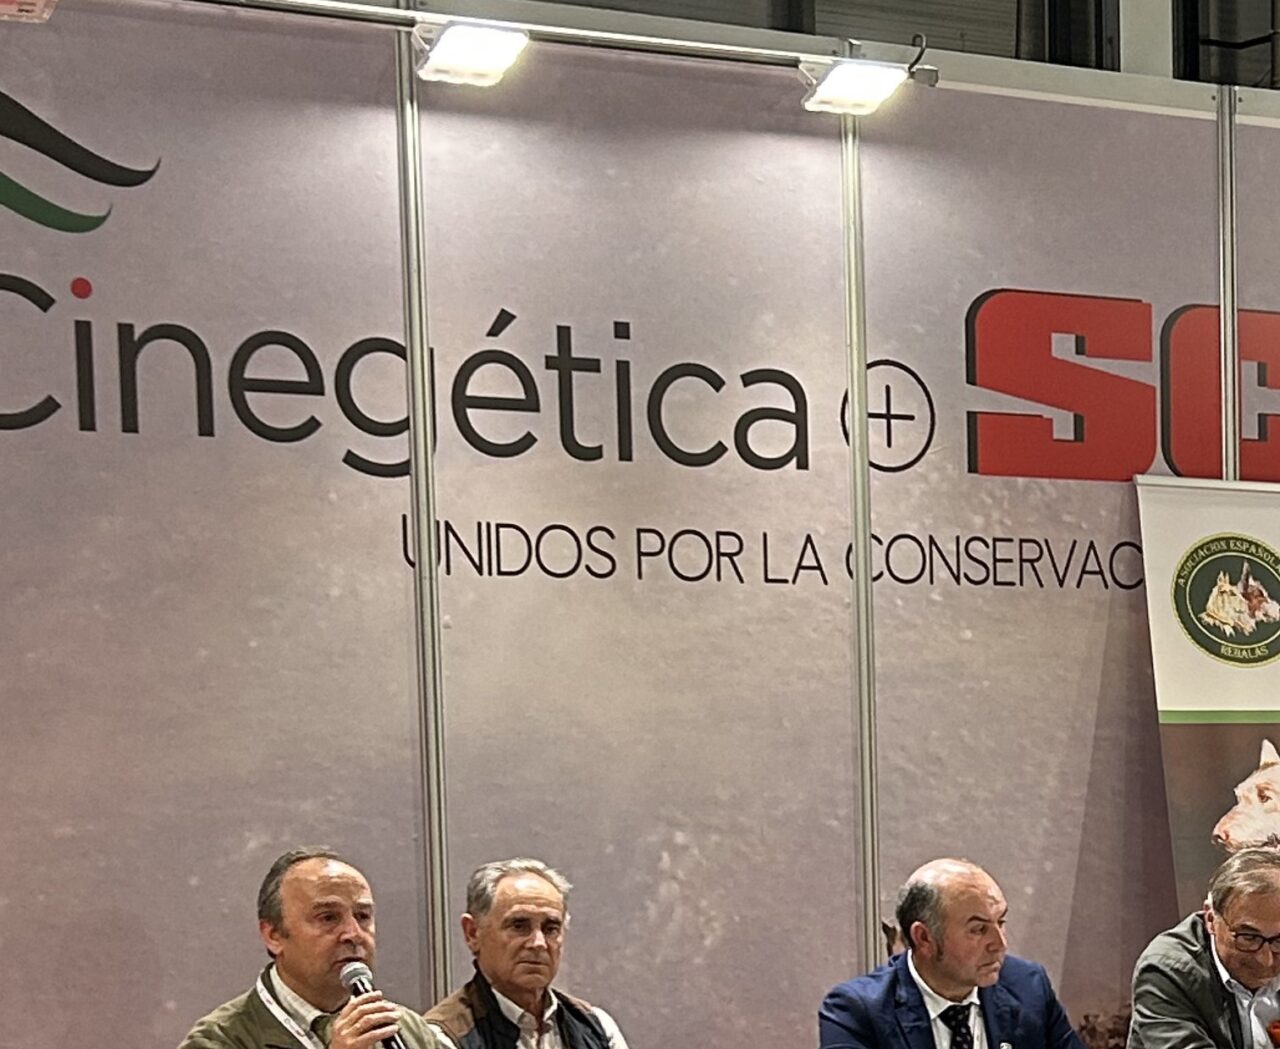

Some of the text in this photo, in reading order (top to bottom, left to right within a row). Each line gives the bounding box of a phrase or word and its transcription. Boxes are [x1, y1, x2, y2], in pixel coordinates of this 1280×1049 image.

[402, 514, 617, 578] UNIDOS
[635, 527, 745, 584] POR
[762, 531, 829, 586] LA
